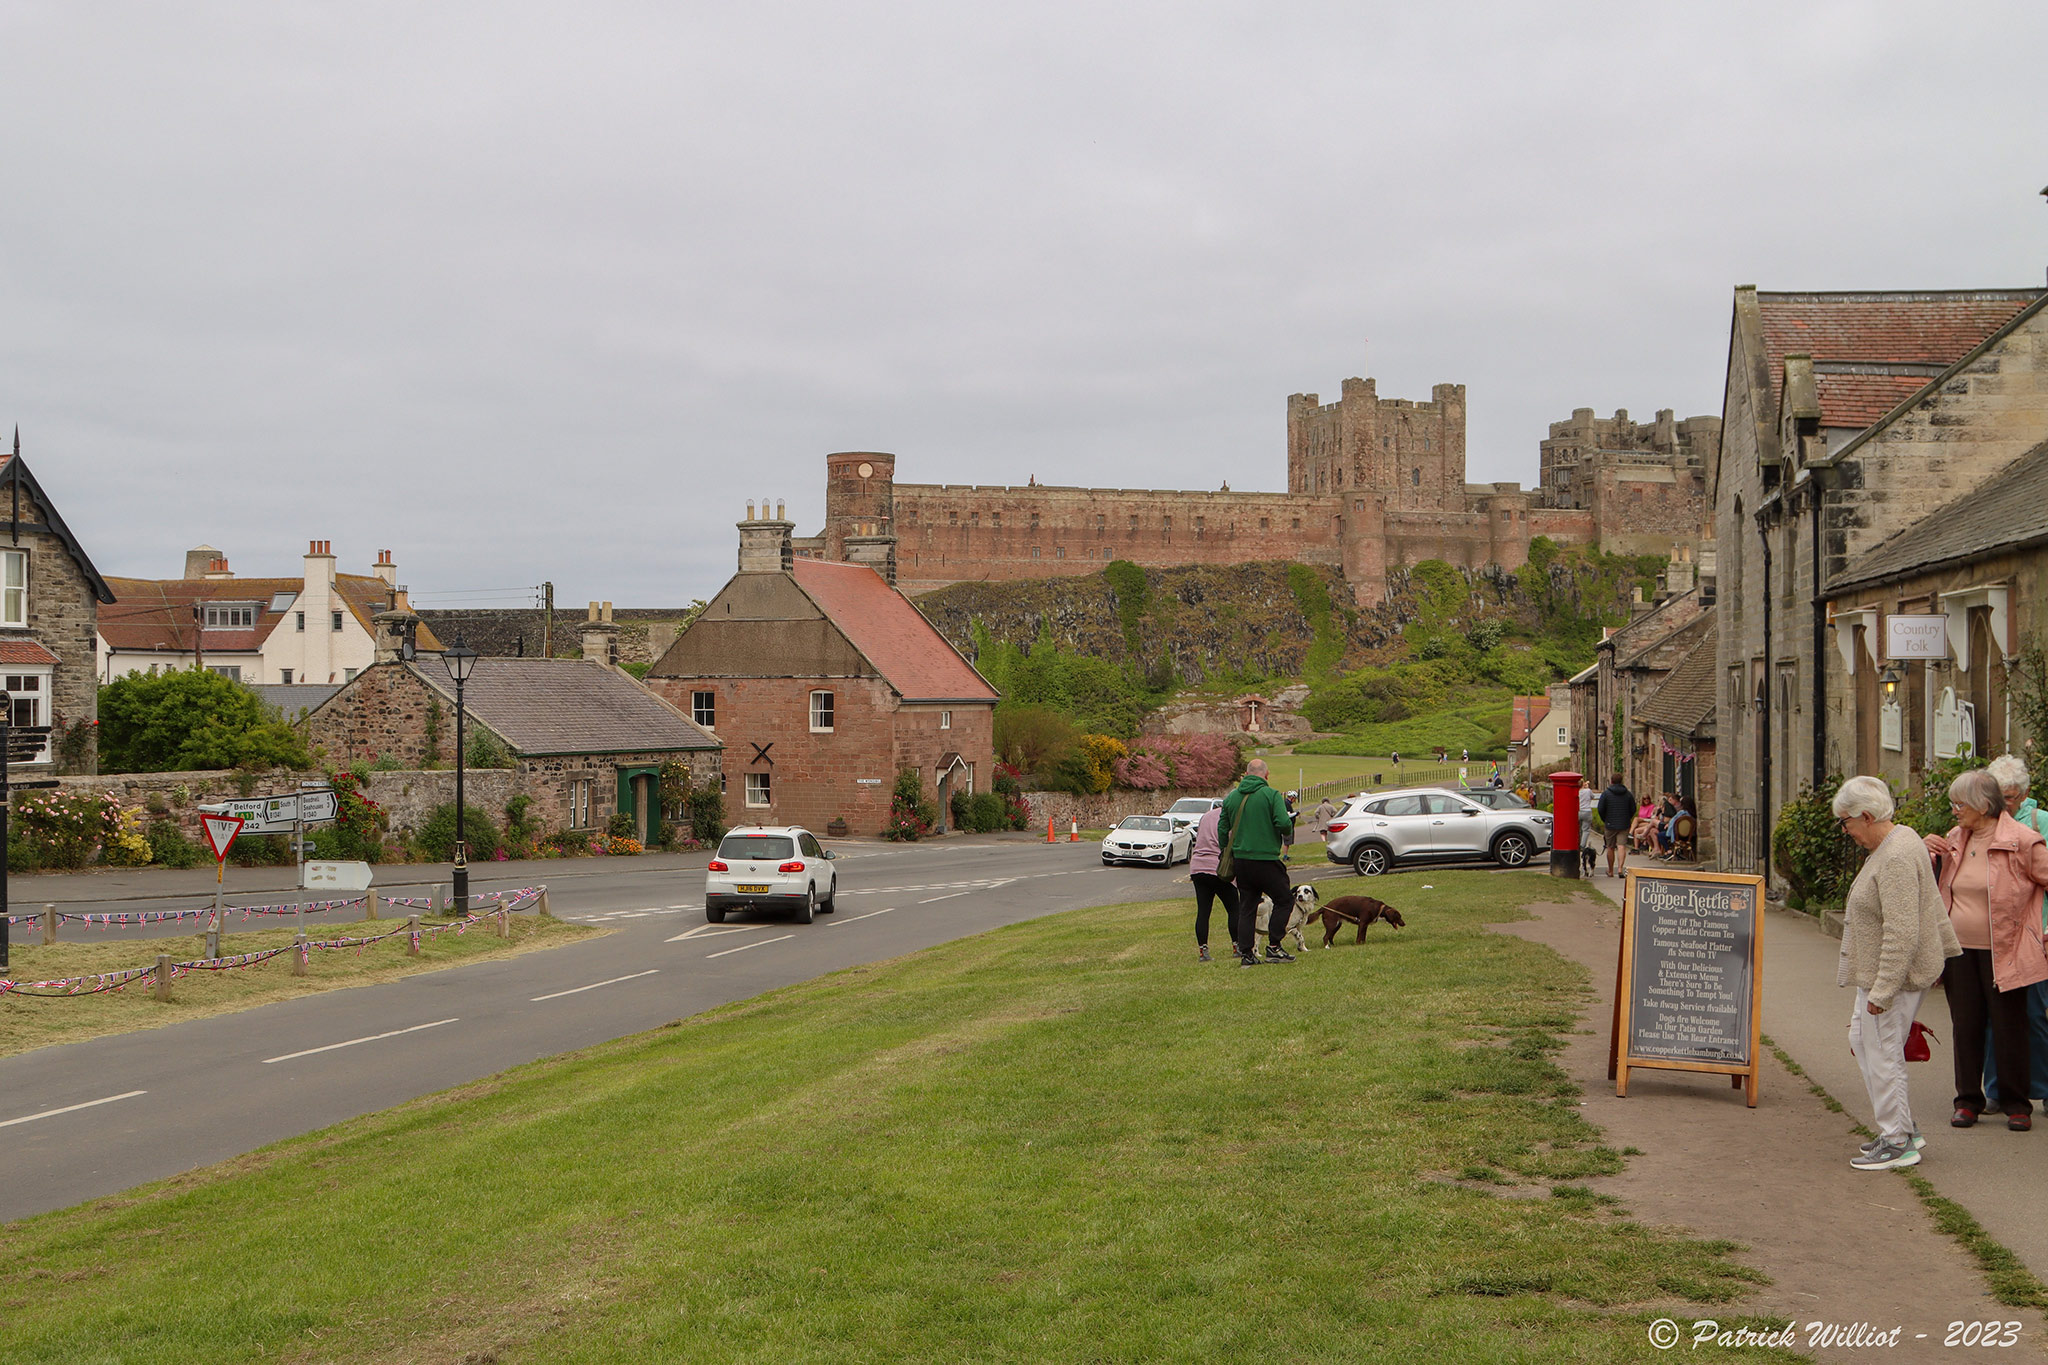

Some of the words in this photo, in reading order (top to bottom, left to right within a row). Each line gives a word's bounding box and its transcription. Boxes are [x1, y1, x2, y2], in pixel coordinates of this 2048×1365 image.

[1894, 623, 1940, 638] Country
[1906, 640, 1928, 652] Folk
[1649, 880, 1668, 894] The
[1641, 886, 1687, 912] Copper
[1688, 888, 1729, 917] Kettle
[1658, 917, 1677, 926] Home
[1680, 918, 1687, 926] Of
[1689, 918, 1702, 928] The
[1704, 920, 1729, 929] Famous
[1652, 925, 1675, 935] Copper
[1678, 927, 1698, 936] Kettle
[1700, 929, 1721, 937] Cream
[1723, 930, 1735, 939] Tea
[1654, 938, 1678, 948] Famous
[1681, 940, 1707, 950] Seafood
[1709, 942, 1732, 952] Platter
[1668, 948, 1676, 956] As
[1678, 949, 1694, 958] Seen
[1696, 950, 1706, 958] On
[1708, 951, 1716, 959] TV
[1660, 960, 1676, 969] With
[1678, 962, 1690, 971] Our
[1692, 963, 1723, 973] Delicious
[1665, 970, 1697, 980] Extensive
[1699, 972, 1719, 981] Menu
[1660, 978, 1684, 988] There's
[1686, 980, 1702, 989] Sure
[1704, 982, 1712, 990] To
[1648, 986, 1684, 998] Something
[1686, 989, 1694, 997] To
[1696, 990, 1717, 1000] Tempt
[1719, 992, 1733, 1000] You!
[1643, 998, 1658, 1008] Take
[1660, 1000, 1678, 1011] Away
[1680, 1002, 1705, 1011] Service
[1707, 1004, 1737, 1014] Available
[1659, 1013, 1675, 1024] Dogs
[1677, 1015, 1688, 1024] Are
[1690, 1016, 1719, 1026] Welcome
[1655, 1022, 1662, 1030] In
[1664, 1022, 1677, 1032] Our
[1679, 1024, 1696, 1033] Patio
[1698, 1025, 1723, 1035] Garden
[1638, 1029, 1659, 1038] Please
[1662, 1031, 1674, 1040] Use
[1676, 1032, 1689, 1041] The
[1691, 1034, 1706, 1042] Rear
[1708, 1035, 1739, 1045] Entrance
[1634, 1045, 1744, 1060] www.copperkettlebamburgh.co.uk
